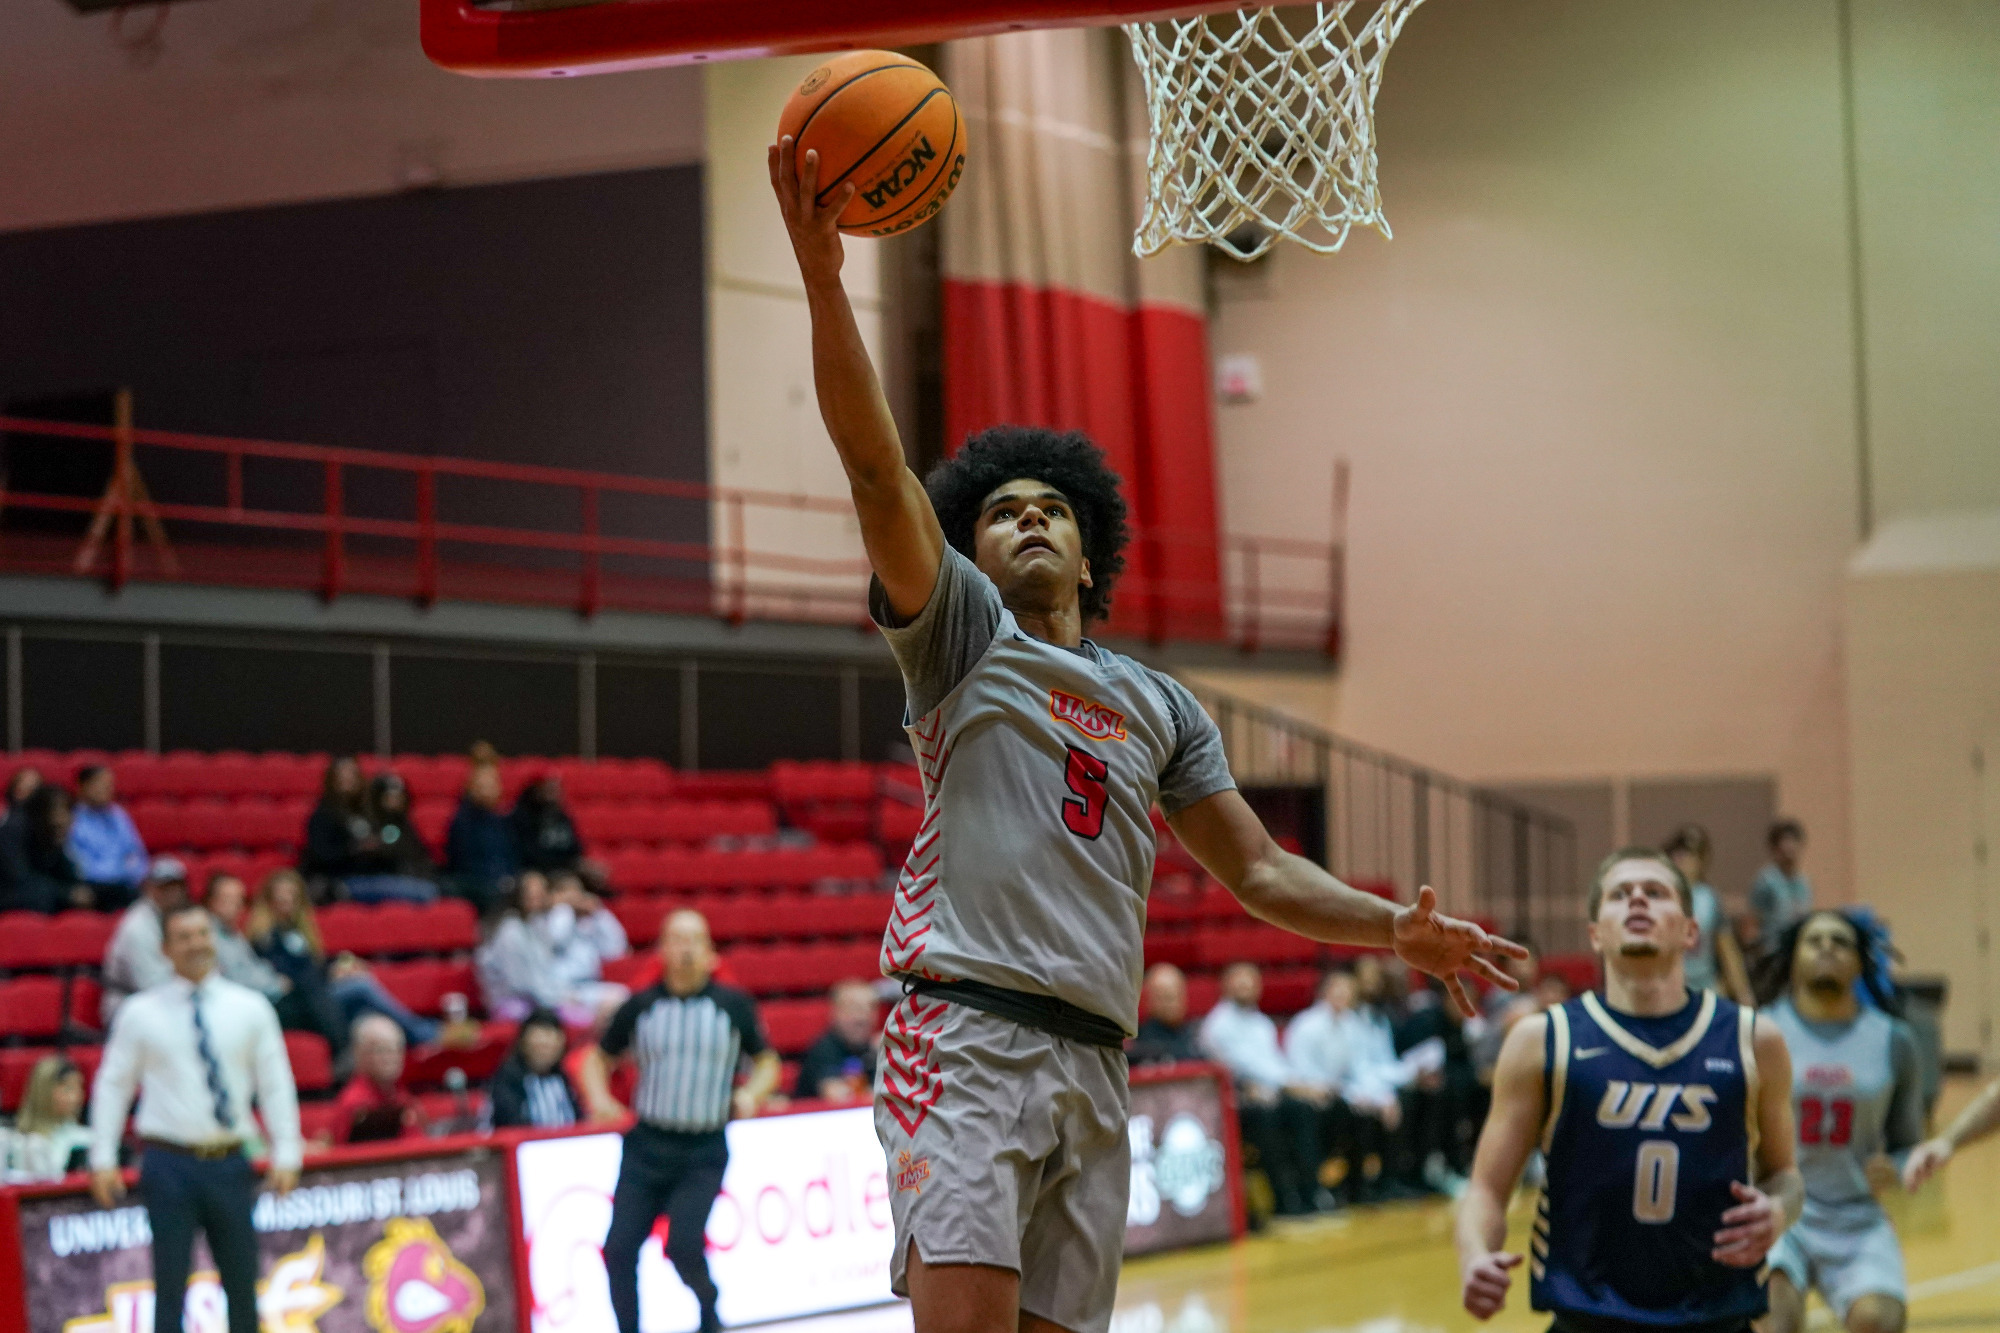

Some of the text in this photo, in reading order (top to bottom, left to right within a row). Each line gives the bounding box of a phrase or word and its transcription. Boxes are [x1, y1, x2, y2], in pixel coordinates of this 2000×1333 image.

[861, 136, 937, 209] NCAA
[1051, 690, 1127, 741] UMSL
[1061, 742, 1110, 841] 5
[1597, 1079, 1719, 1132] UIS
[897, 1162, 930, 1191] UMSL
[1632, 1140, 1680, 1225] 0
